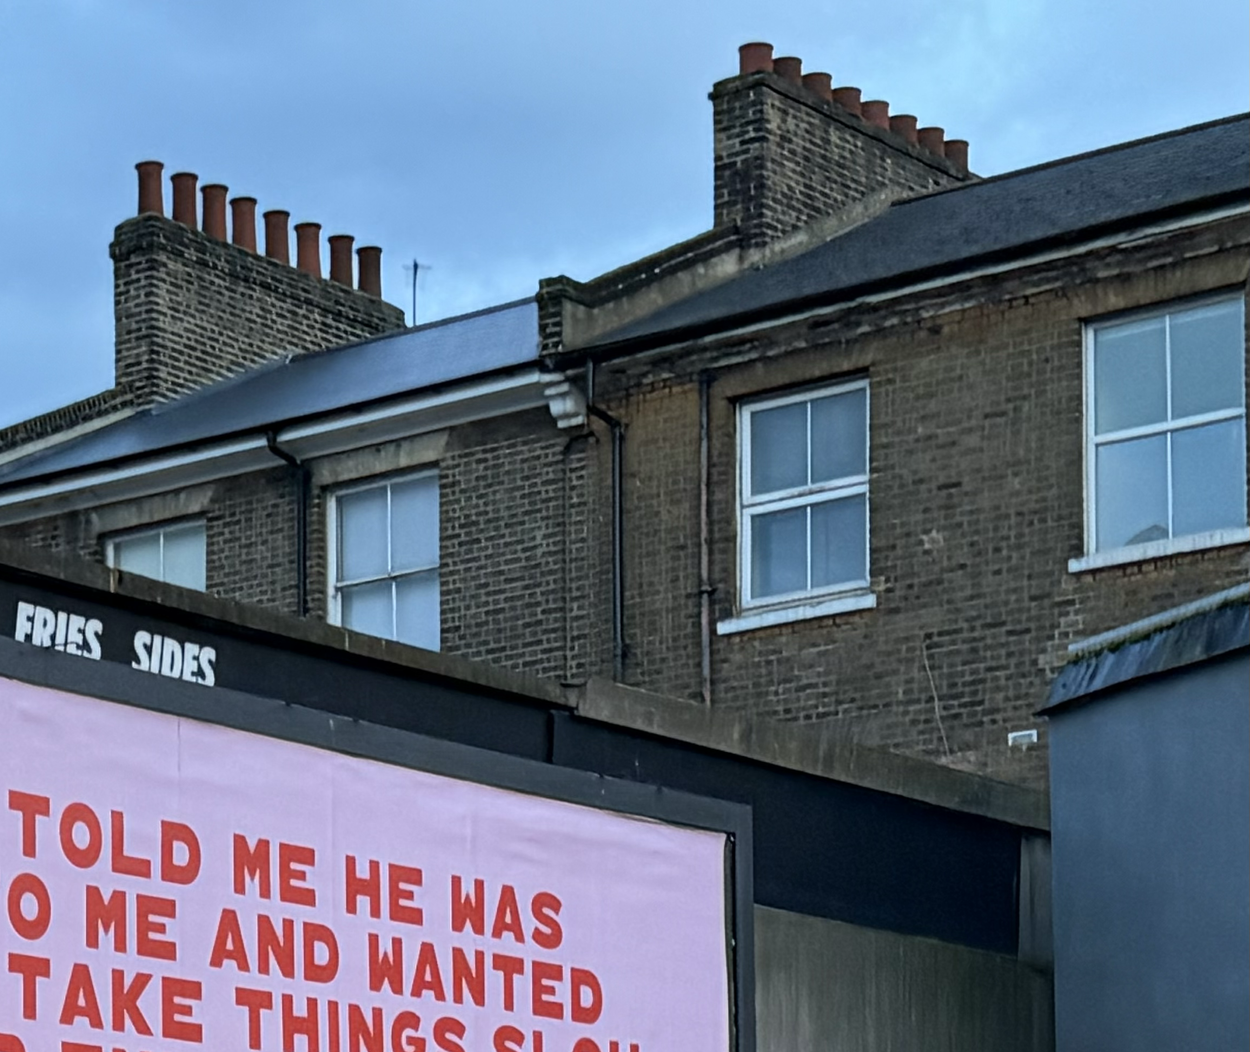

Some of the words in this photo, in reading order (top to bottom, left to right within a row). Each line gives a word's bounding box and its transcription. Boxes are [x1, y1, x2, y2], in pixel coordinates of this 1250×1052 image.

[14, 600, 104, 661] FRIES
[131, 630, 217, 687] SIDES
[8, 790, 201, 885] TOLD
[233, 833, 316, 908] ME
[345, 854, 424, 926] HE
[451, 875, 563, 950] WAS
[7, 952, 203, 1043] TAKE
[85, 884, 177, 962] ME
[209, 907, 340, 984] AND
[367, 932, 603, 1025] WANTED
